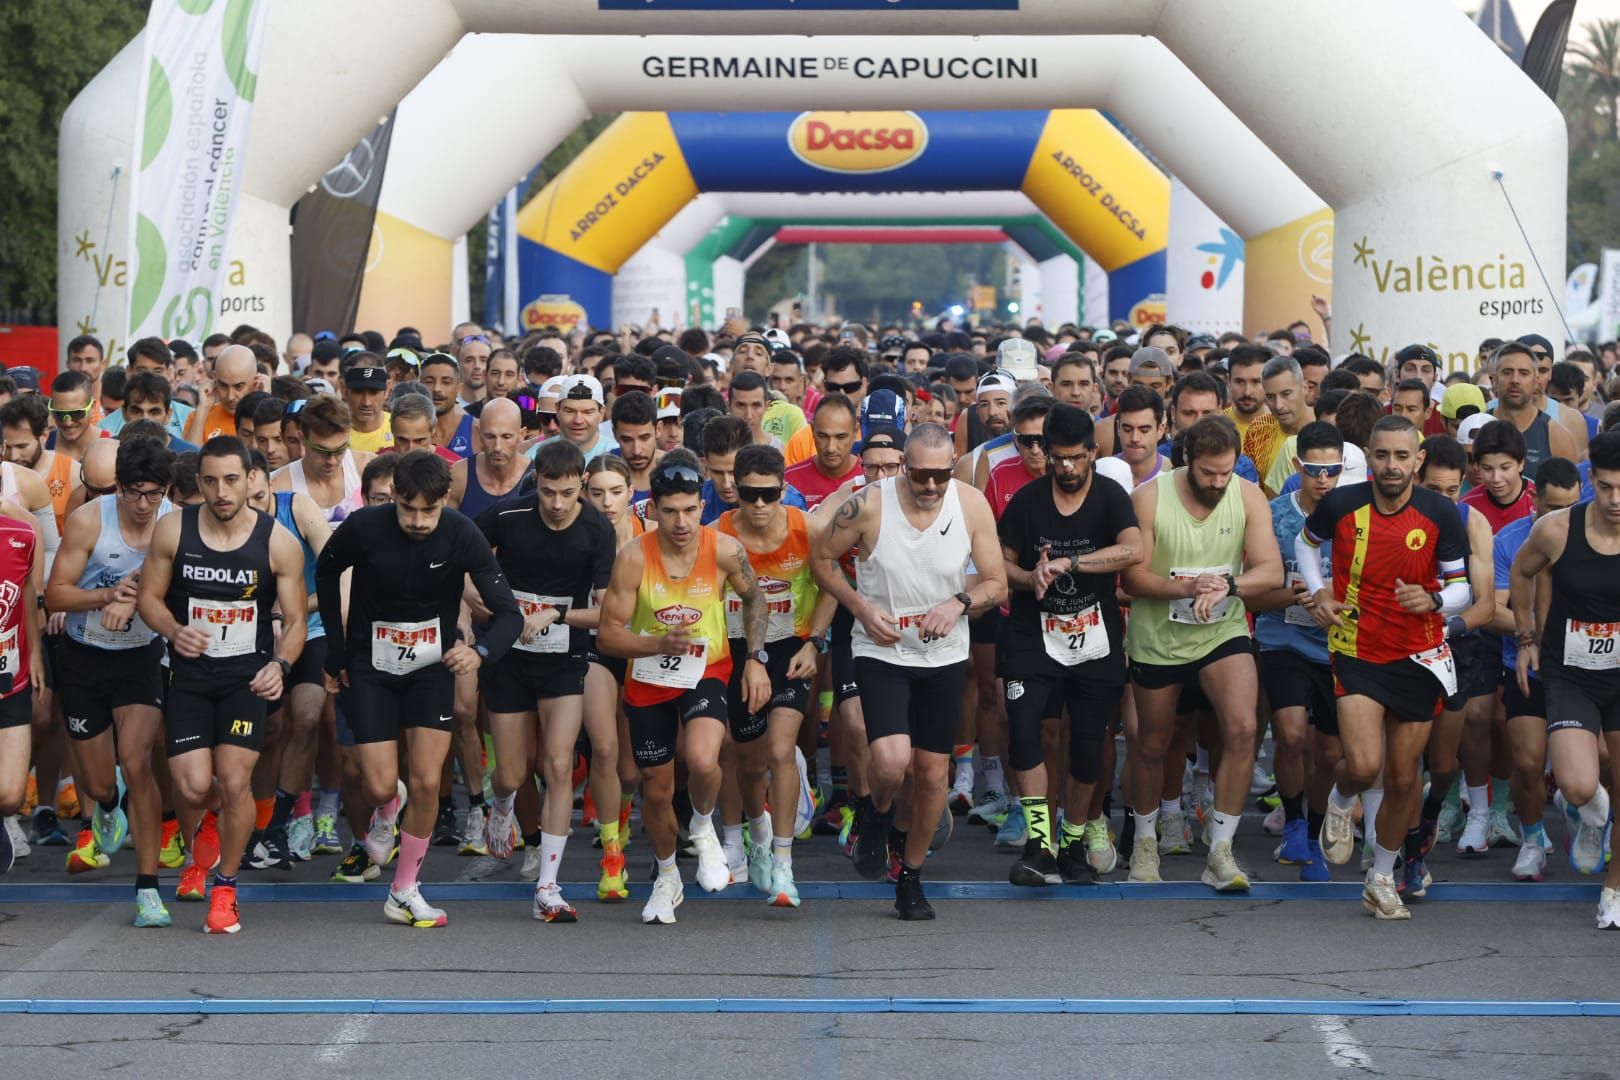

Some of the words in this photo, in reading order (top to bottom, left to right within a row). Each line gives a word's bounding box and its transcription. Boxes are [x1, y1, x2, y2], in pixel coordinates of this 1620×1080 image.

[642, 56, 819, 78] GERMAINE
[824, 57, 848, 70] DE
[853, 57, 1037, 79] CAPUCCINI
[187, 52, 208, 151] española
[806, 121, 914, 151] Dacsa
[569, 194, 618, 242] ARROZ
[615, 152, 665, 197] DACSA
[1051, 150, 1103, 197] ARROZ
[1099, 193, 1147, 241] DACSA
[208, 244, 223, 271] en
[1372, 254, 1525, 293] València
[220, 294, 265, 316] ports
[1479, 296, 1544, 320] esports
[659, 611, 699, 621] Serrao
[220, 625, 228, 641] 1
[1068, 632, 1086, 650] 27
[397, 646, 416, 661] 74
[1588, 638, 1615, 654] 120
[659, 655, 682, 671] 32
